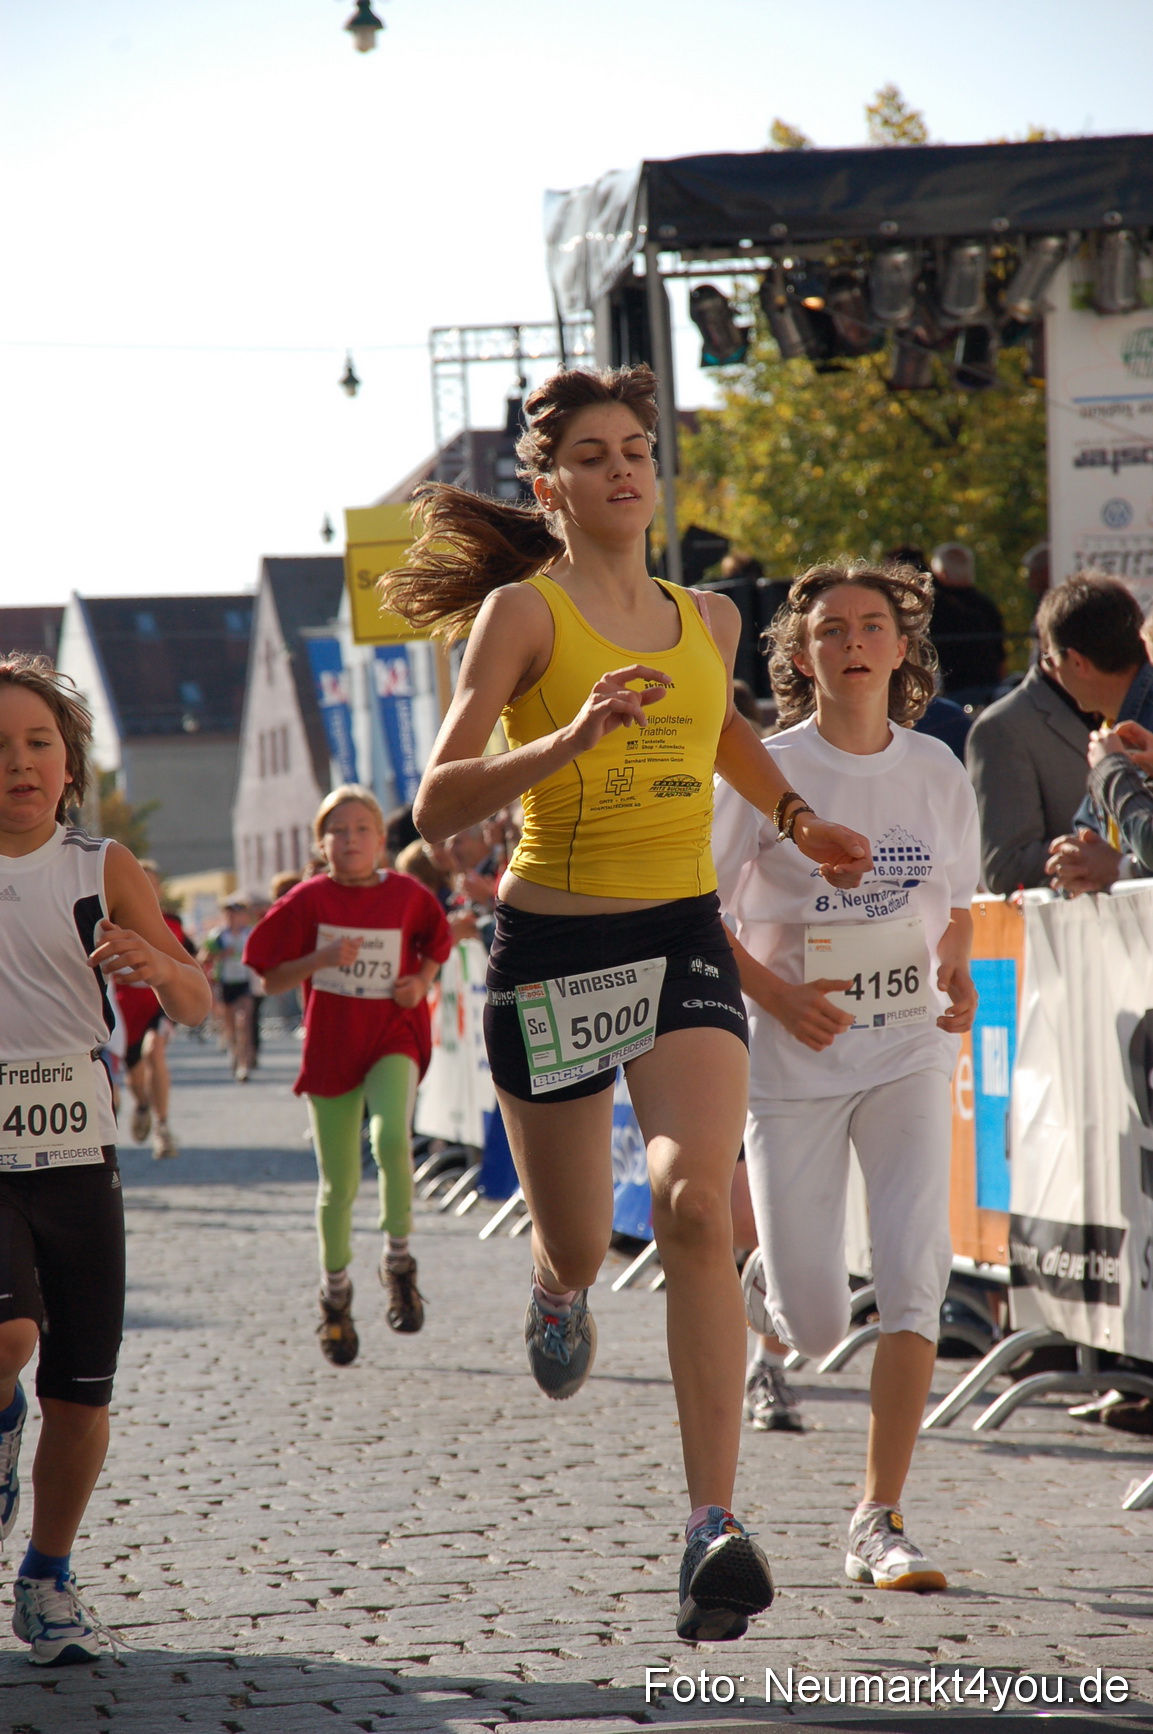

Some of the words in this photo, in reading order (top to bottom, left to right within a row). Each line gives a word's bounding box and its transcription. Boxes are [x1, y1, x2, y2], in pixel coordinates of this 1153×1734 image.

[639, 727, 677, 737] Triathlon
[872, 865, 933, 877] 16.09.2007
[815, 895, 838, 912] 8.
[555, 968, 637, 998] Vanessa
[845, 965, 919, 1001] 4156
[571, 997, 650, 1050] 5000
[886, 1006, 927, 1021] PFLEIDERER
[527, 1018, 547, 1035] Sc
[611, 1035, 653, 1061] PFLEIDERER
[0, 1062, 73, 1085] Frederic
[533, 1065, 584, 1088] BOCK
[2, 1101, 88, 1137] 4009
[49, 1147, 100, 1160] PFLEIDERER
